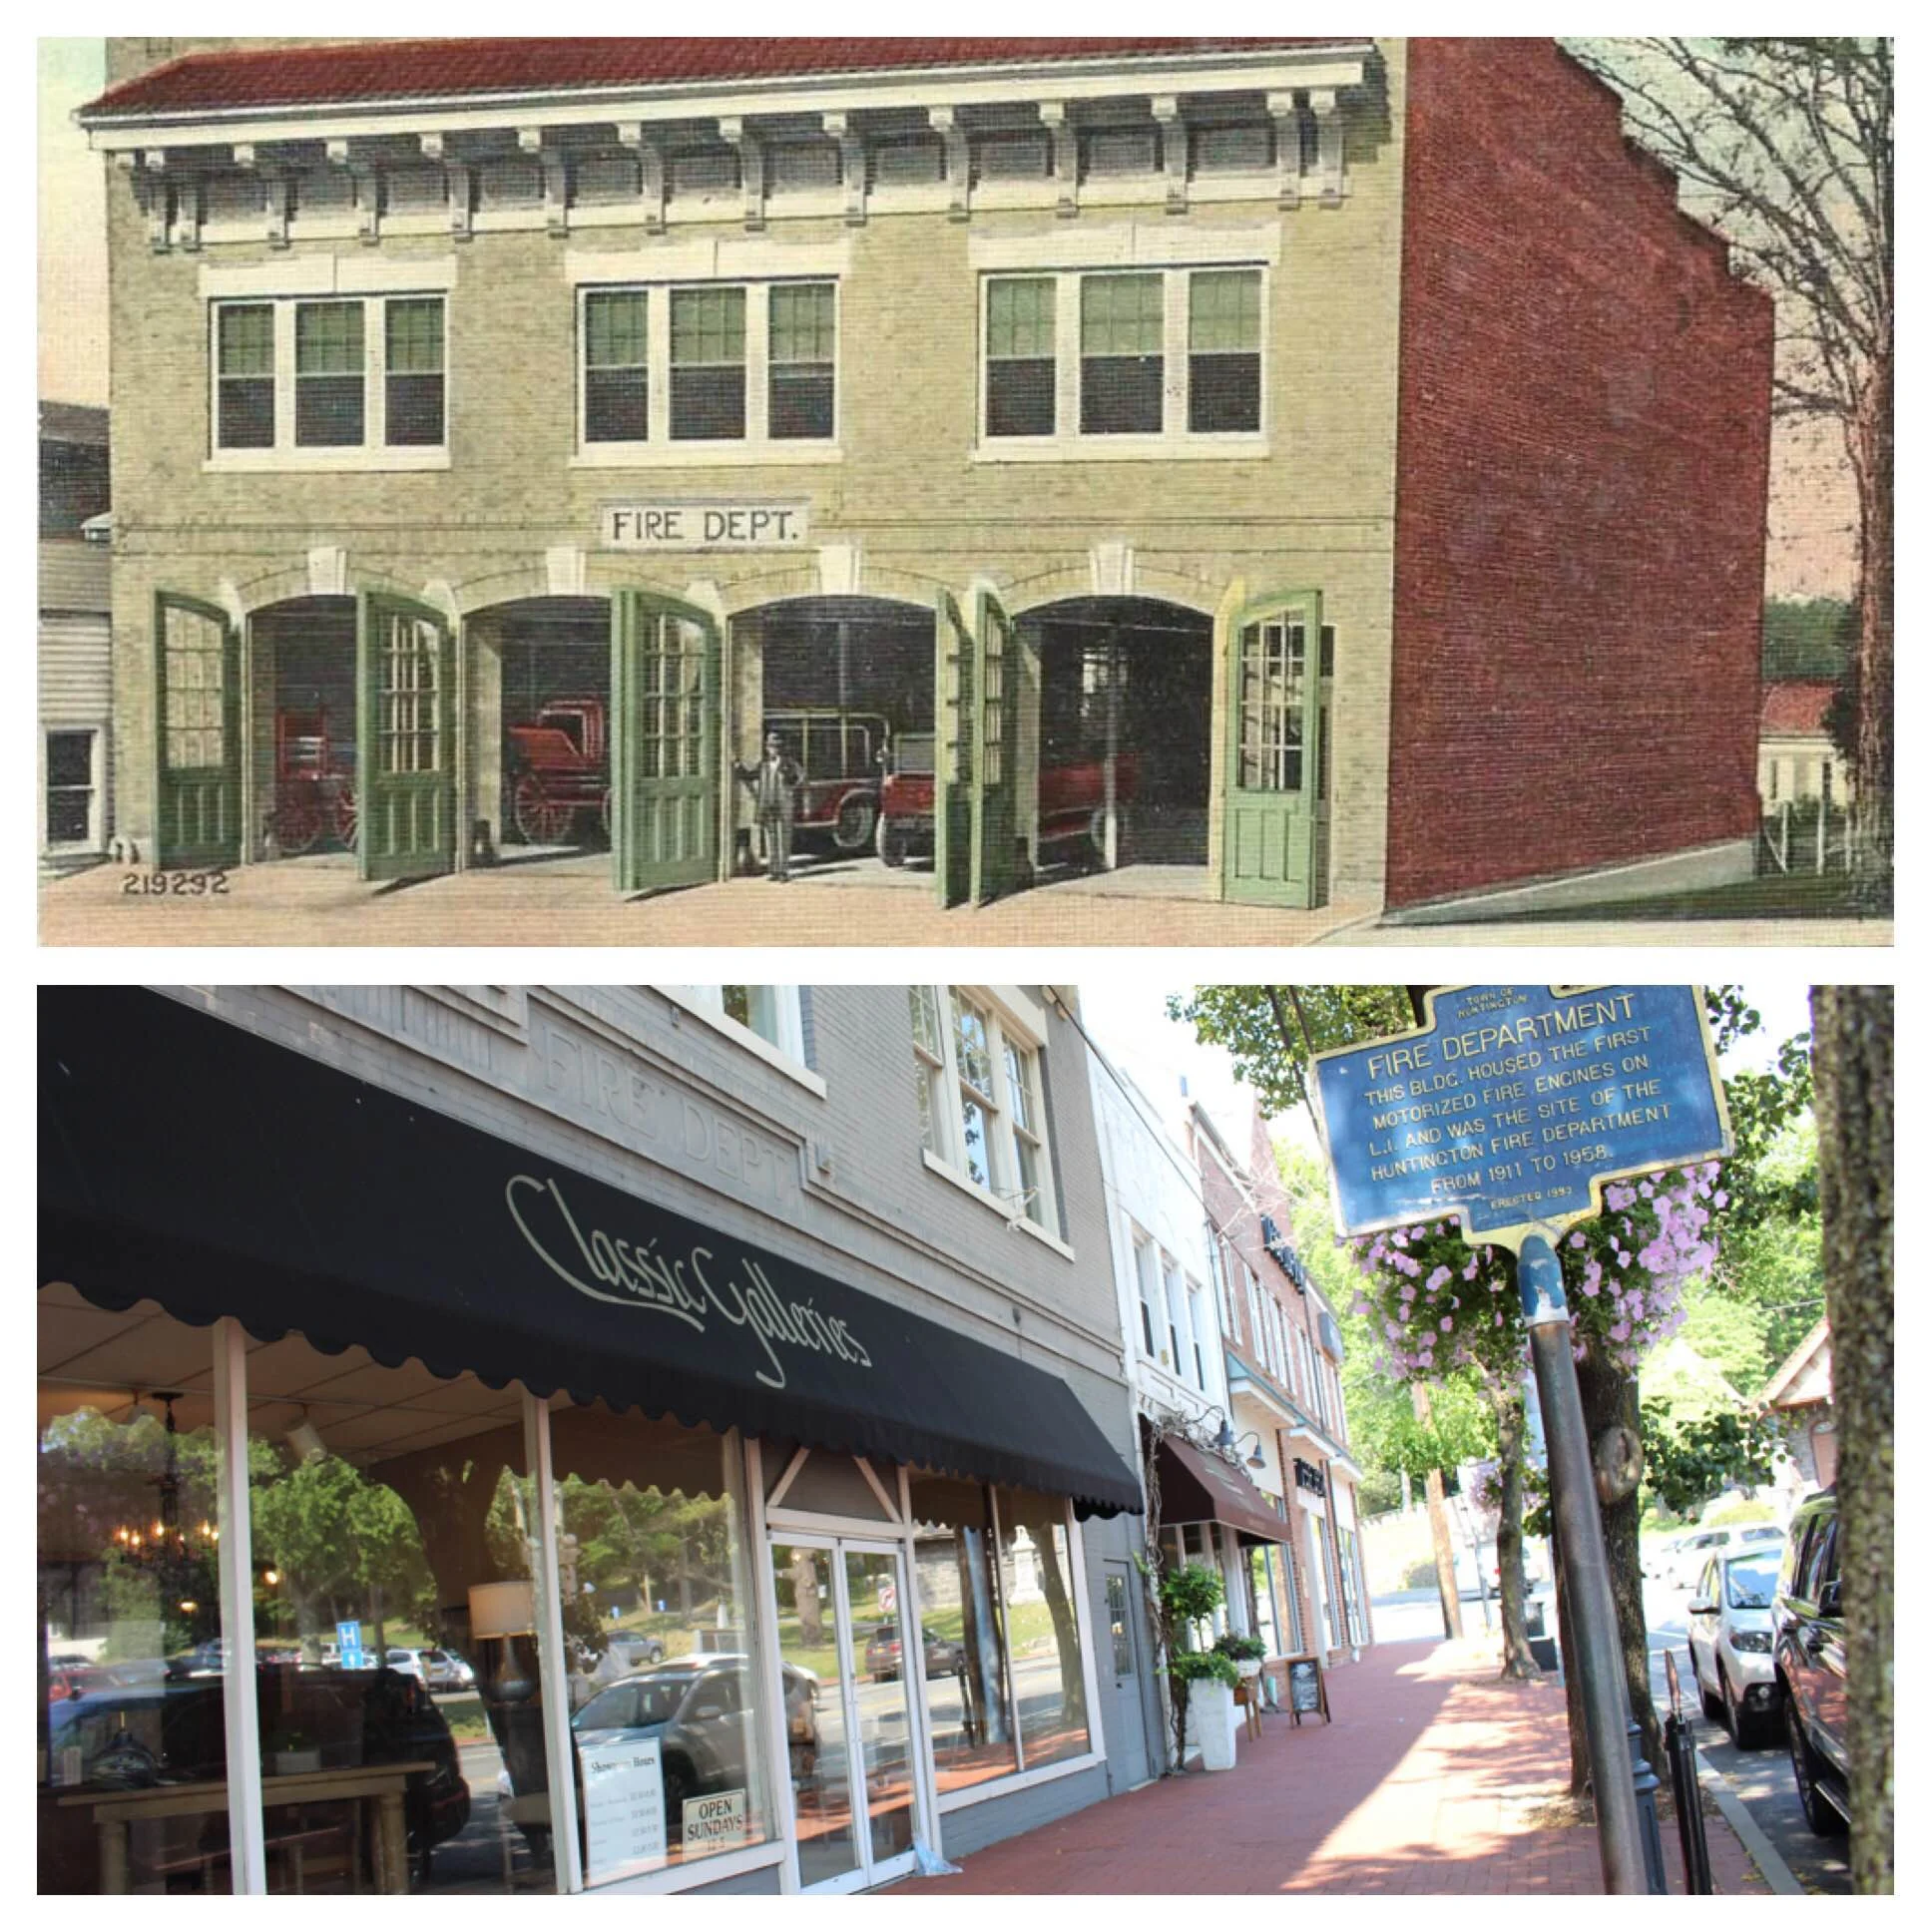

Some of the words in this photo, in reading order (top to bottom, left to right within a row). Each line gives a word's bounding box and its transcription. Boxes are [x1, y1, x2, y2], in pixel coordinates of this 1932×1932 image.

[613, 510, 685, 541] FIRE
[703, 510, 798, 541] DEPT.
[1500, 986, 1515, 997] OF
[1364, 1084, 1406, 1107] THIS
[1468, 1050, 1542, 1081] HOUSED
[1549, 1040, 1589, 1064] THE
[1594, 1026, 1652, 1054] FIRST
[1367, 1044, 1433, 1080] FIRE
[1442, 992, 1636, 1062] DEPARTMENT
[542, 1020, 659, 1142] FIRE
[1373, 1093, 1477, 1131] MOTORIZED
[1483, 1082, 1526, 1105] FIRE
[1535, 1061, 1617, 1094] ENGINES
[1622, 1053, 1650, 1074] ON
[1405, 1127, 1442, 1149] AND
[1447, 1118, 1487, 1140] WAS
[1492, 1107, 1532, 1129] THE
[1538, 1097, 1582, 1120] SITE
[1591, 1086, 1617, 1107] OF
[1622, 1078, 1663, 1101] THE
[1371, 1143, 1485, 1183] HUNTINGTON
[1491, 1131, 1535, 1155] FIRE
[1542, 1103, 1672, 1144] DEPARTMENT
[1430, 1171, 1482, 1195] FROM
[1488, 1163, 1523, 1184] 1911
[1531, 1156, 1557, 1174] TO
[506, 1175, 708, 1332] Classic
[691, 1247, 872, 1388] Galleries
[699, 1798, 732, 1820] OPEN
